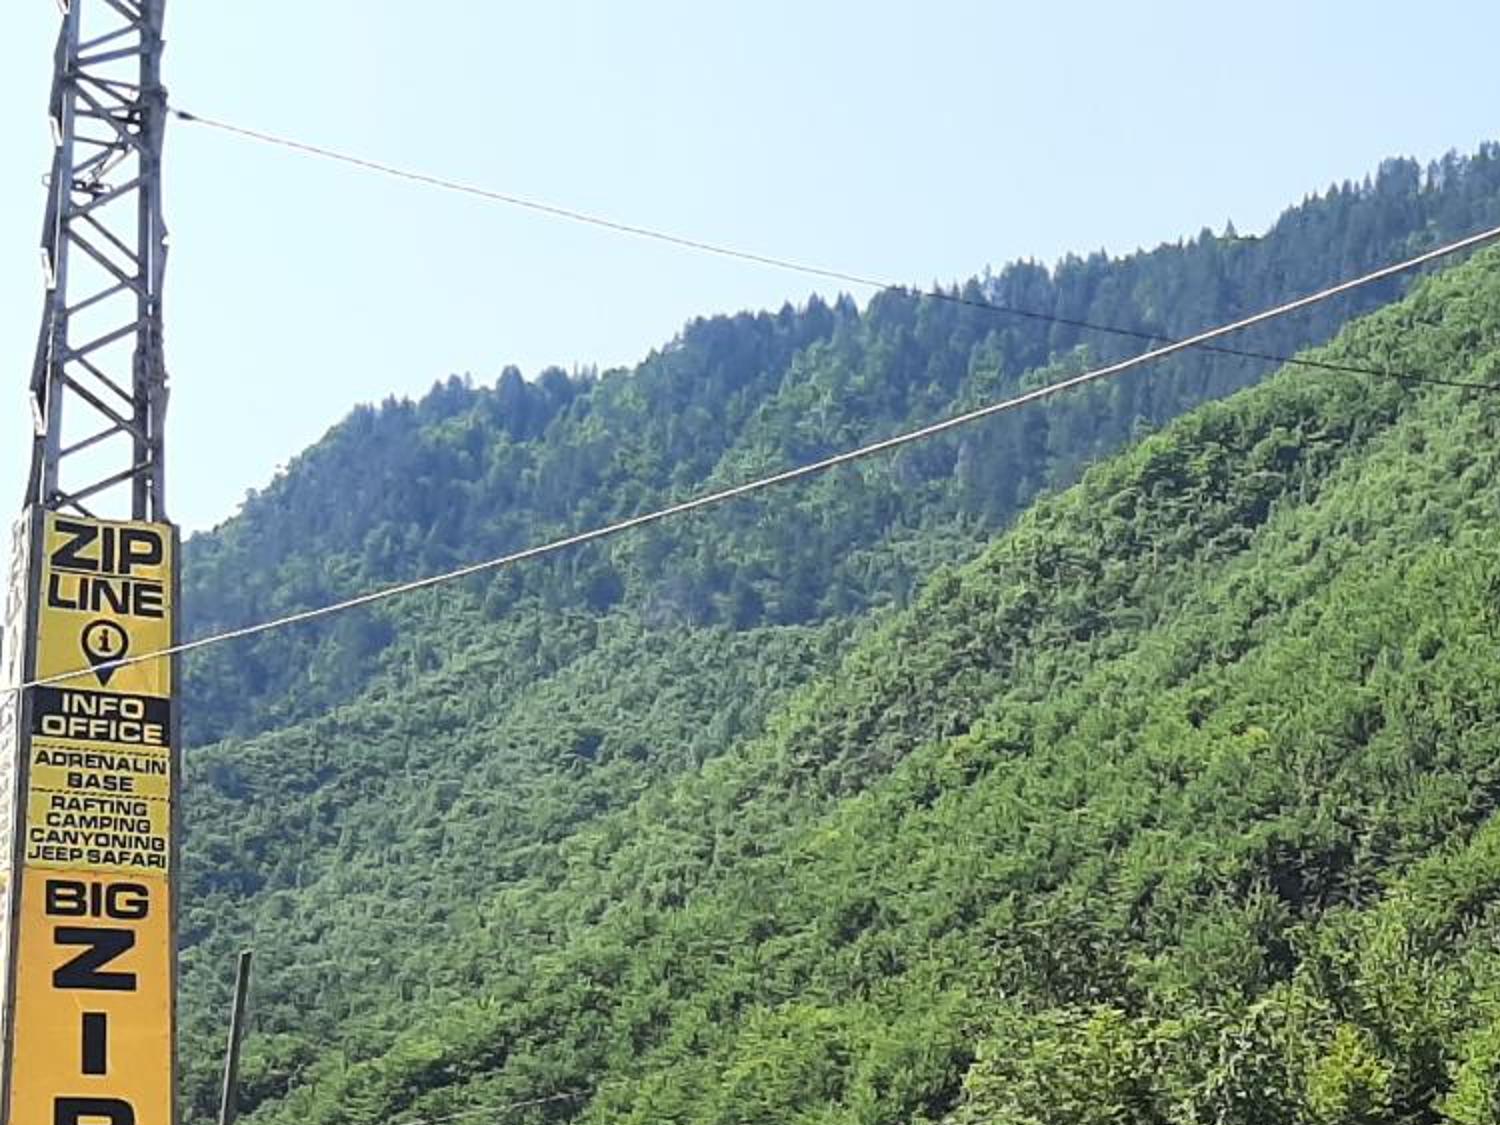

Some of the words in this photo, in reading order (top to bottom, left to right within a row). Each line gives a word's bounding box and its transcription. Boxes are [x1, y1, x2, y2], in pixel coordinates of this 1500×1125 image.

[51, 521, 163, 574] ZIP
[48, 574, 164, 618] LINE
[62, 693, 144, 719] INFO
[41, 715, 163, 744] OFFICE
[35, 750, 166, 775] ADRENALIN
[67, 772, 134, 792] BASE
[51, 796, 147, 816] RAFTING
[46, 812, 151, 834] CAMPING
[30, 828, 165, 851] CANYONING
[28, 846, 82, 861] JEEP
[88, 850, 165, 868] SAFARI
[45, 879, 149, 919] BIG
